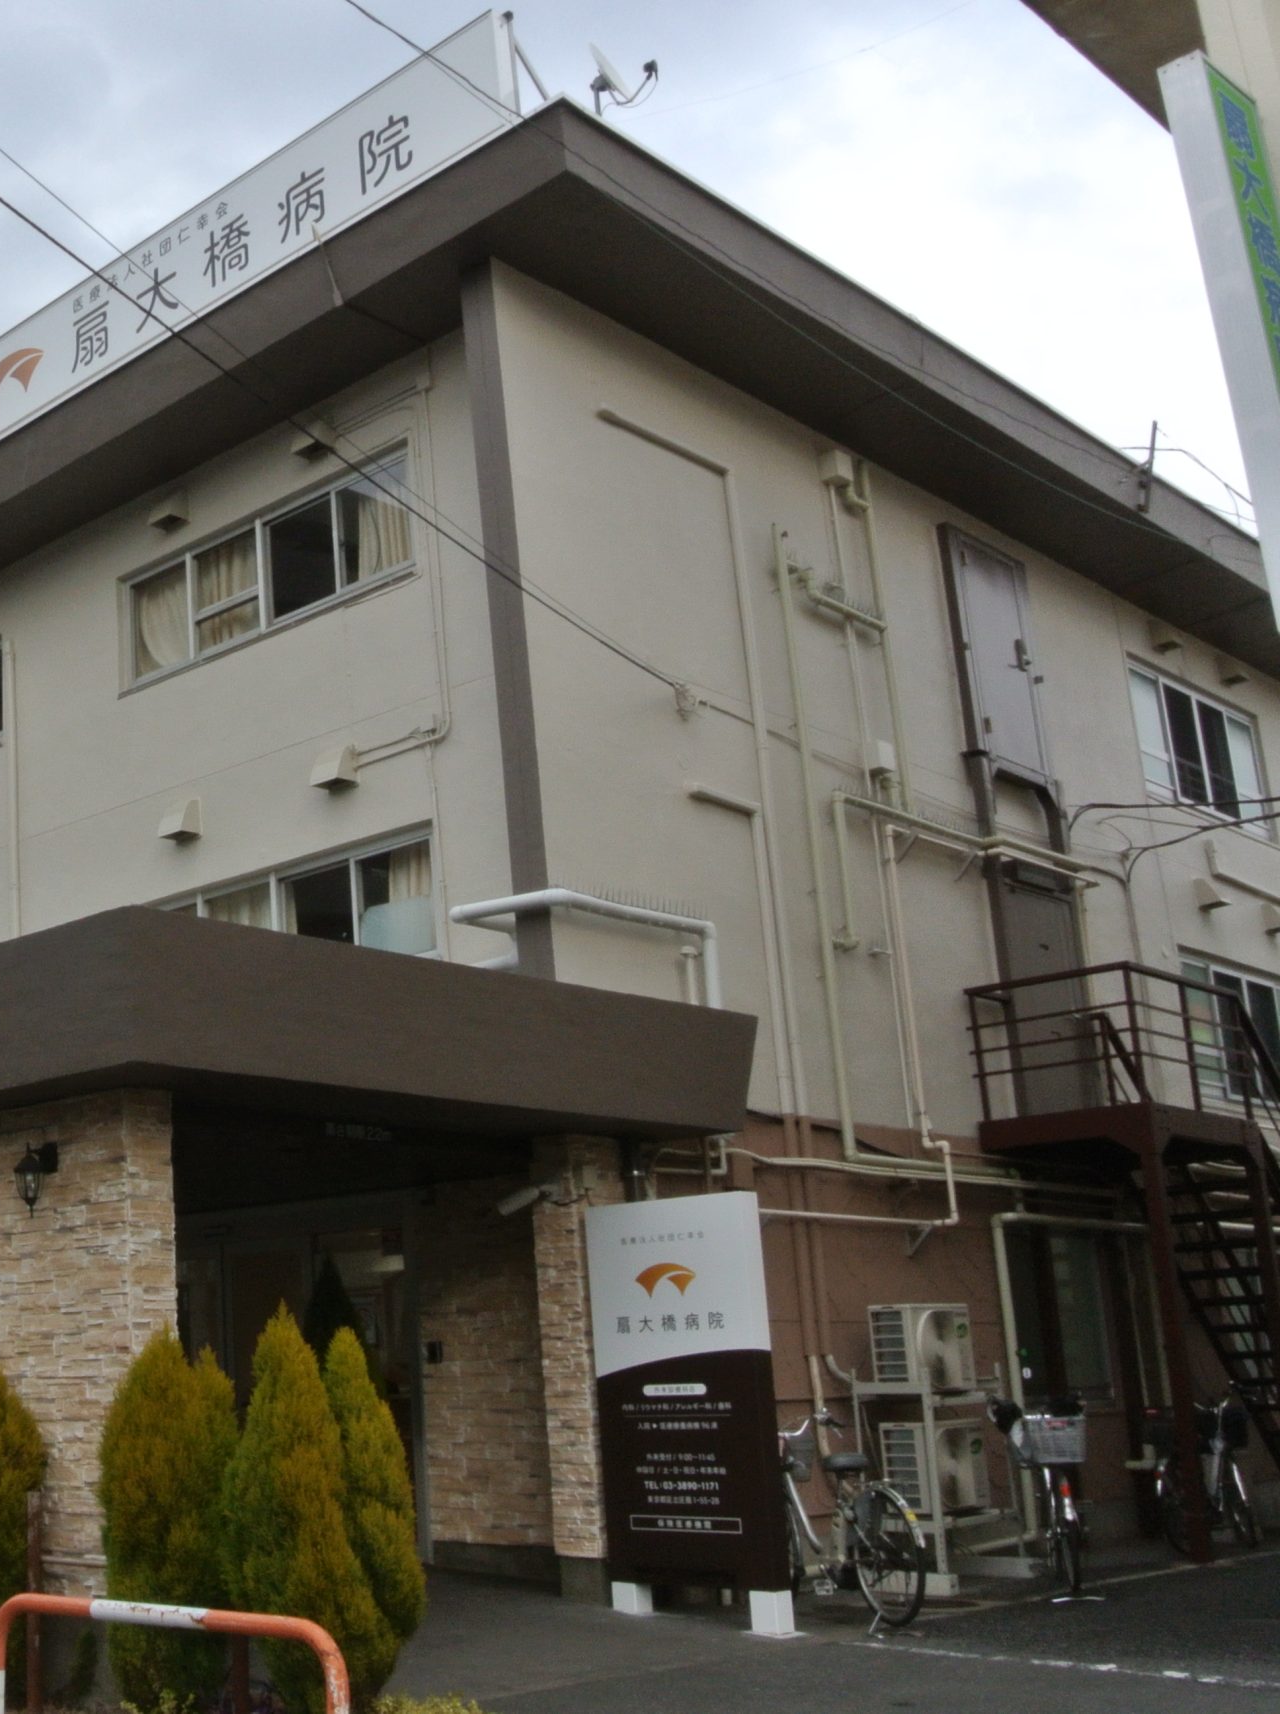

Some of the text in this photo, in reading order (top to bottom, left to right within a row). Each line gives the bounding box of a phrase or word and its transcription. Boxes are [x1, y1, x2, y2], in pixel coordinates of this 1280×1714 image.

[71, 114, 414, 374] 扇大橋病院
[616, 1311, 726, 1334] 扇大橋病院
